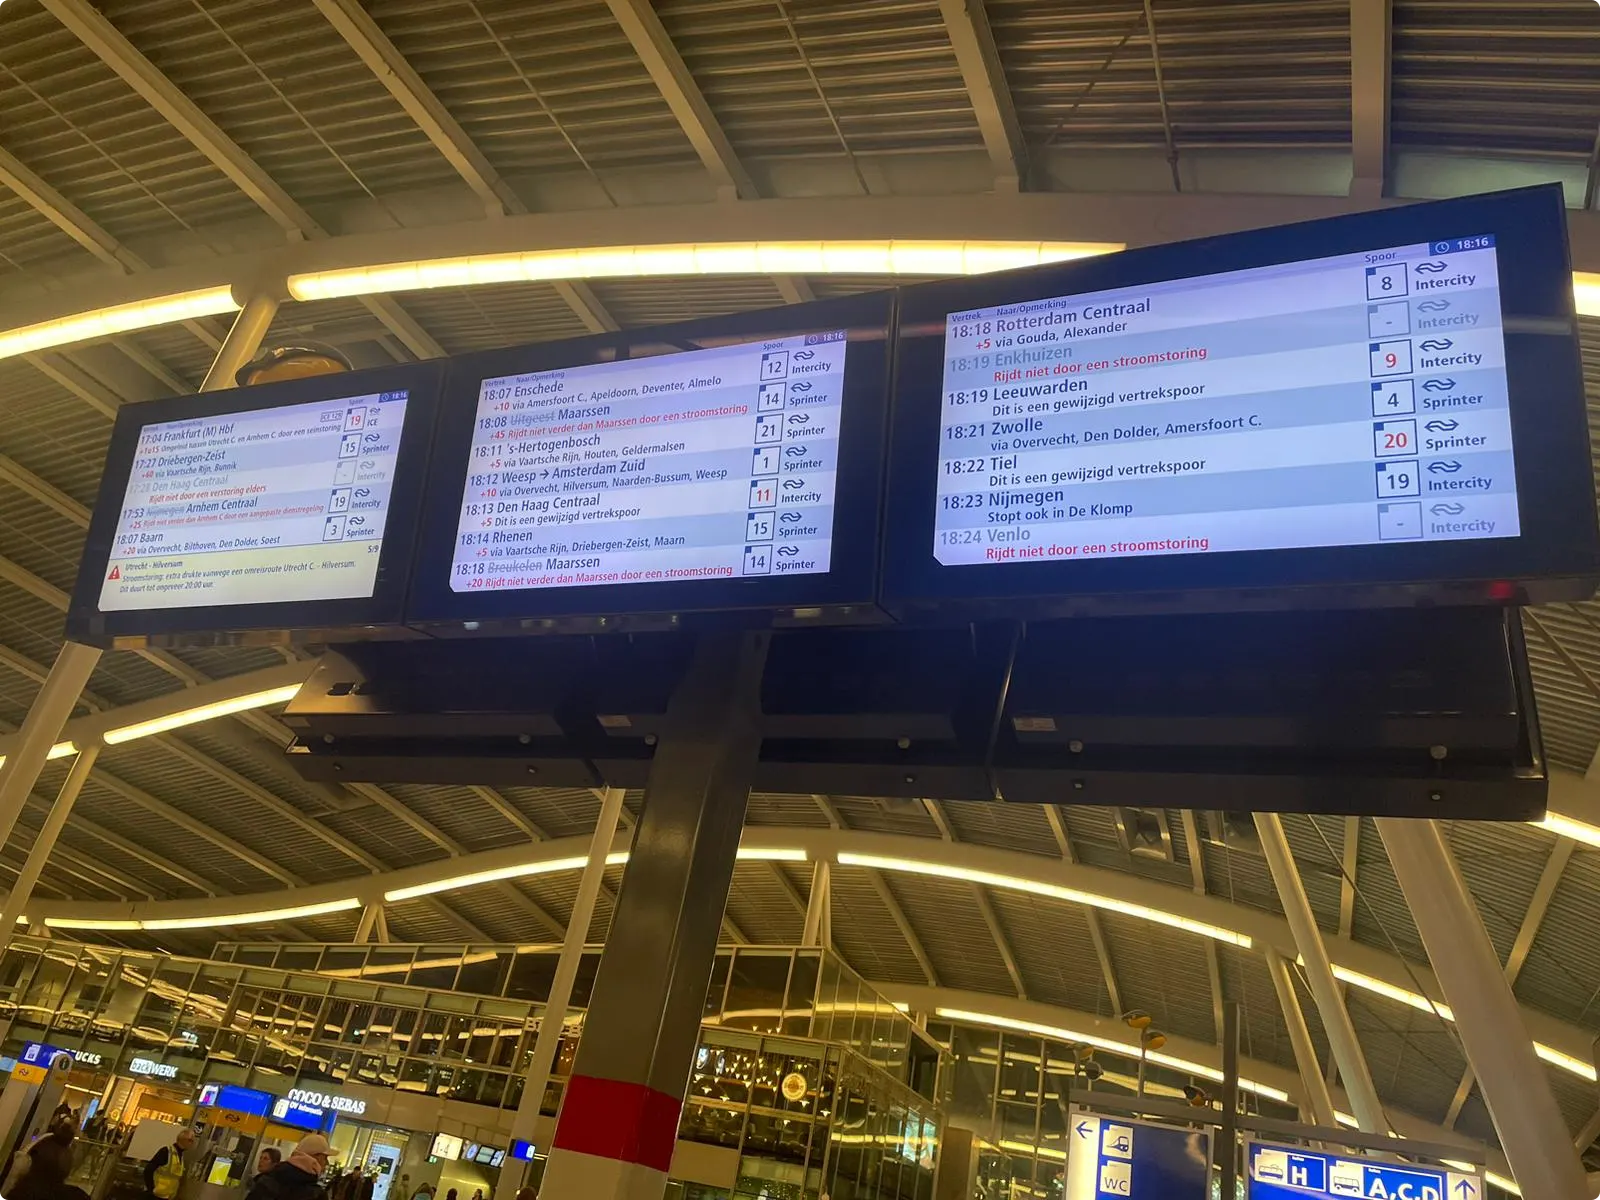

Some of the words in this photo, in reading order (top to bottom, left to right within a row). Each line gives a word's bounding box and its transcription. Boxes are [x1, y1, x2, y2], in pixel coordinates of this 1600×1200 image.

[1457, 237, 1488, 249] 18:16
[1364, 252, 1396, 264] Spoor
[1381, 276, 1392, 290] 8
[1416, 274, 1476, 290] Intercity
[952, 311, 981, 322] Vertrek
[996, 300, 1067, 316] Naar/Opmerking
[952, 321, 991, 338] 18:18
[996, 311, 1077, 333] Rotterdam
[1082, 297, 1150, 320] Centraal
[1418, 313, 1479, 329] Intercity
[823, 331, 843, 341] 18:16
[976, 338, 991, 349] +5
[995, 336, 1013, 348] via
[1016, 330, 1059, 345] Gouda,
[1063, 321, 1127, 339] Alexander
[768, 360, 782, 373] 12
[951, 355, 990, 372] 18:19
[995, 346, 1072, 366] Enkhuizen
[994, 369, 1021, 383] Rijdt
[1025, 366, 1049, 378] niet
[1053, 363, 1082, 374] door
[1086, 360, 1109, 370] een
[1113, 347, 1207, 368] stroomstoring
[1385, 353, 1396, 368] 9
[1420, 352, 1482, 368] Intercity
[792, 361, 831, 374] Intercity
[484, 387, 512, 401] 18:07
[514, 380, 564, 397] Enschede
[494, 401, 510, 411] +10
[512, 400, 525, 410] via
[526, 394, 575, 408] Amersfoort
[590, 388, 638, 402] Apeldoorn,
[642, 382, 685, 394] Deventer,
[687, 375, 722, 388] Almelo
[765, 392, 779, 405] 14
[948, 389, 988, 406] 18:19
[993, 378, 1088, 401] Leeuwarden
[789, 394, 827, 407] Sprinter
[992, 404, 1010, 416] Dit
[1014, 403, 1023, 414] is
[1027, 402, 1049, 412] een
[1053, 392, 1114, 412] gewijzigd
[1118, 385, 1205, 402] vertrekspoor
[1387, 392, 1399, 407] 4
[1423, 395, 1483, 410] Sprinter
[351, 415, 361, 426] 19
[366, 418, 378, 427] ICE
[479, 416, 507, 429] 18:08
[510, 412, 554, 427] Uitgeest
[558, 406, 610, 420] Maarssen
[141, 433, 162, 444] 17:04
[163, 428, 201, 442] Frankfurt
[202, 425, 217, 439] (M)
[218, 422, 235, 435] Hbf
[761, 424, 775, 437] 21
[787, 426, 825, 439] Sprinter
[946, 423, 984, 440] 18:21
[991, 417, 1043, 435] Zwolle
[991, 439, 1008, 451] via
[1012, 433, 1079, 449] Overvecht,
[1084, 431, 1109, 442] Den
[1114, 425, 1160, 439] Dolder,
[1164, 417, 1244, 434] Amersfoort
[1248, 414, 1261, 426] C.
[346, 441, 356, 453] 15
[475, 444, 502, 458] 18:11
[507, 433, 600, 454] 's-Hertogenbosch
[1384, 432, 1407, 448] 20
[1425, 435, 1486, 451] Sprinter
[362, 444, 390, 455] Sprinter
[135, 457, 157, 469] 17:27
[157, 449, 226, 467] Driebergen-Zeist
[763, 456, 768, 468] 1
[784, 459, 822, 472] Sprinter
[944, 458, 984, 475] 18:22
[990, 454, 1017, 471] Tiel
[470, 473, 498, 486] 18:12
[502, 472, 536, 484] Weesp
[551, 462, 616, 479] Amsterdam
[619, 458, 646, 473] Zuid
[989, 474, 1007, 486] Dit
[1011, 473, 1021, 484] is
[1024, 473, 1047, 483] een
[1051, 465, 1113, 484] gewijzigd
[1117, 460, 1206, 476] vertrekspoor
[152, 482, 168, 492] Den
[192, 474, 229, 488] Centraal
[1387, 473, 1409, 490] 19
[1428, 476, 1492, 491] Intercity
[335, 496, 346, 507] 19
[757, 489, 769, 502] 11
[781, 491, 822, 503] Intercity
[943, 494, 983, 510] 18:23
[989, 490, 1064, 509] Nijmegen
[123, 507, 145, 519] 17:53
[185, 501, 219, 513] Arnhem
[221, 496, 258, 510] Centraal
[351, 499, 381, 509] Intercity
[466, 502, 494, 516] 18:13
[497, 502, 518, 513] Den
[521, 499, 550, 512] Haag
[552, 492, 600, 509] Centraal
[988, 510, 1021, 524] Stopt
[1025, 507, 1048, 520] ook
[1053, 506, 1064, 518] in
[1069, 506, 1086, 517] De
[1090, 503, 1133, 516] Klomp
[331, 524, 338, 536] 3
[346, 528, 375, 538] Sprinter
[754, 522, 768, 535] 15
[778, 526, 818, 538] Sprinter
[1431, 519, 1495, 534] Intercity
[116, 533, 139, 545] 18:07
[139, 532, 164, 543] Baarn
[218, 539, 233, 548] Den
[260, 536, 280, 545] Soest
[461, 532, 489, 545] 18:14
[492, 530, 533, 543] Rhenen
[940, 530, 982, 546] 18:24
[987, 526, 1030, 543] Venlo
[986, 546, 1015, 561] Rijdt
[1019, 545, 1044, 558] niet
[1047, 544, 1078, 556] door
[1082, 544, 1106, 554] een
[1110, 536, 1208, 552] stroomstoring
[456, 562, 485, 576] 18:18
[488, 559, 542, 573] Breukelen
[546, 558, 600, 570] Maarssen
[750, 555, 765, 568] 14
[775, 559, 815, 572] Sprinter
[288, 1088, 322, 1106] COCO
[322, 1095, 332, 1108] &
[330, 1096, 366, 1114] SEBAS
[1292, 1165, 1307, 1186] H
[1104, 1176, 1128, 1192] WC
